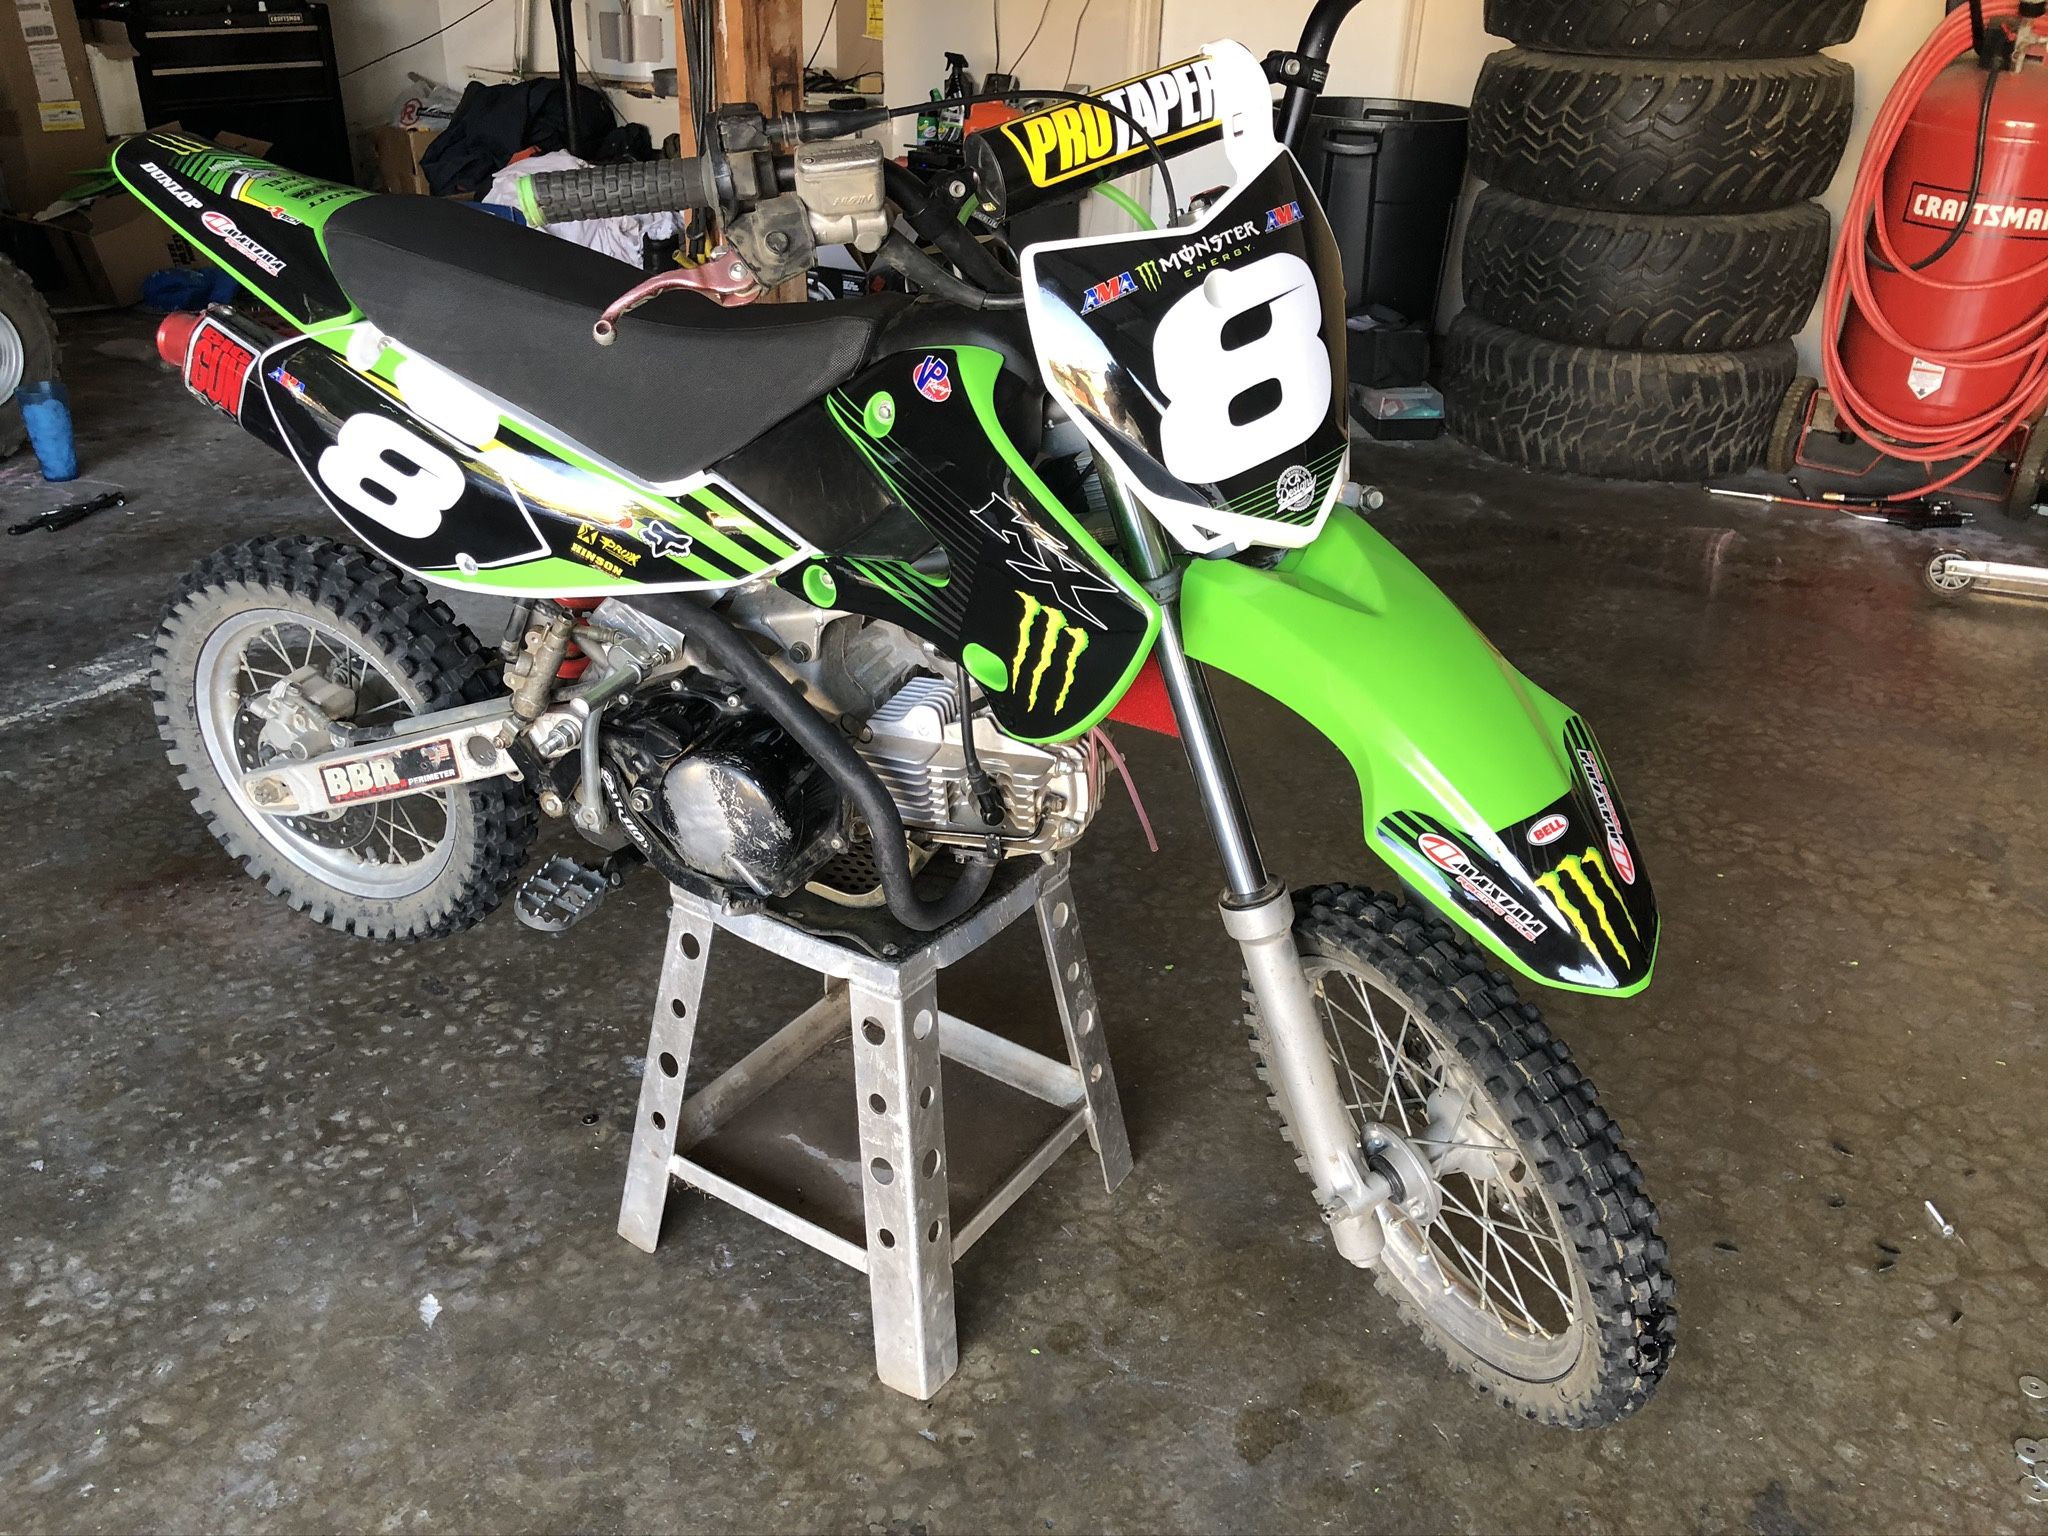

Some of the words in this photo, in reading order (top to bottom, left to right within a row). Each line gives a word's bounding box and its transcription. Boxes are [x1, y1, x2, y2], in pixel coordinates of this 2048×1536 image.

[140, 162, 203, 209] DUNLOP
[1265, 201, 1304, 233] AMA
[1159, 220, 1260, 272] MONSTER
[1184, 244, 1252, 279] ENERGY
[1080, 271, 1139, 315] AMA
[201, 325, 254, 366] BIG
[190, 339, 247, 416] GUN
[1153, 252, 1332, 484] 8
[318, 412, 466, 539] 8
[570, 542, 623, 576] HINSON
[323, 758, 400, 797] BBR
[408, 768, 456, 786] PERIMETER
[1533, 819, 1565, 841] BELL
